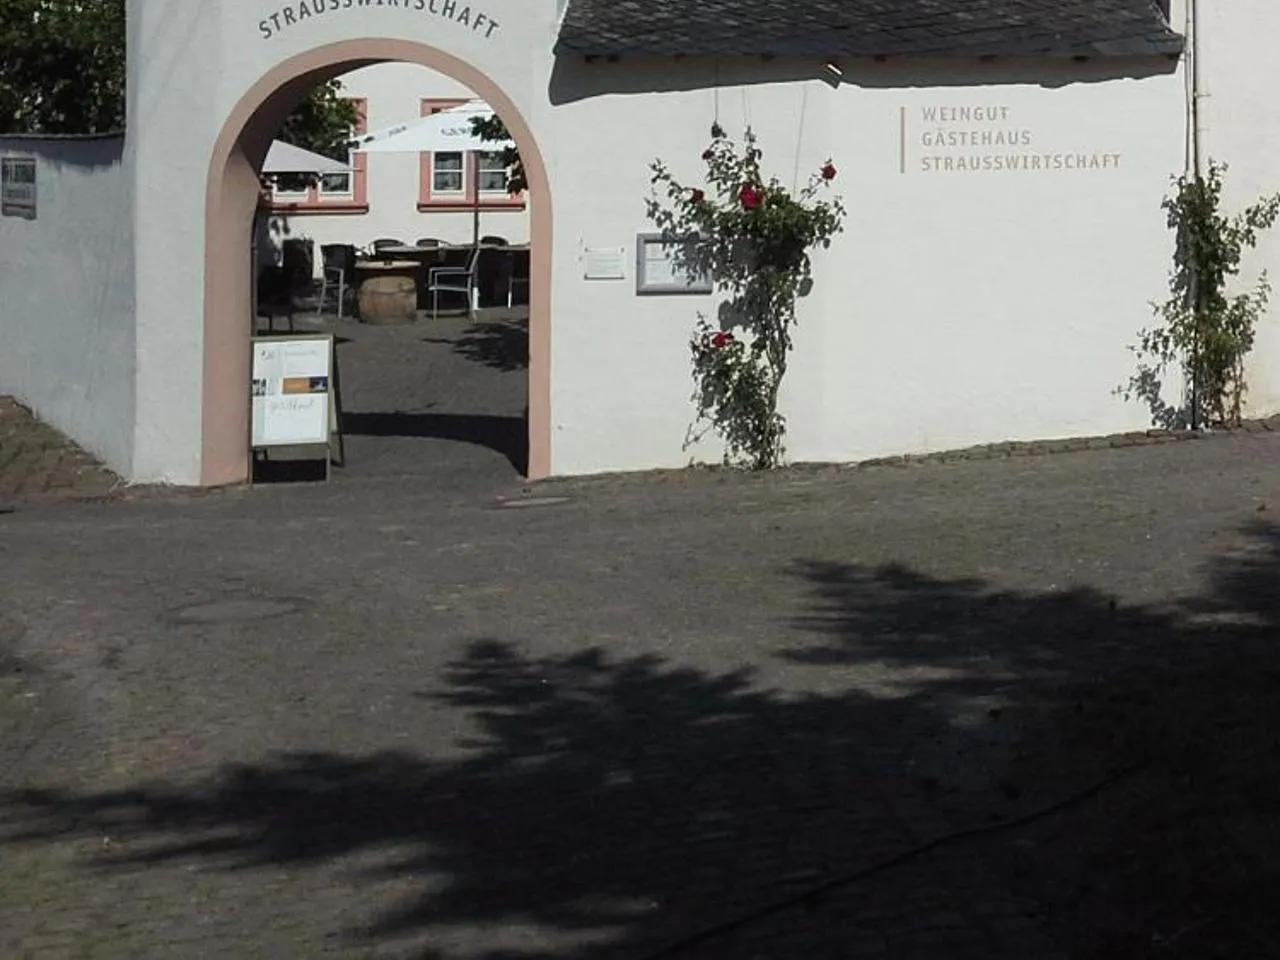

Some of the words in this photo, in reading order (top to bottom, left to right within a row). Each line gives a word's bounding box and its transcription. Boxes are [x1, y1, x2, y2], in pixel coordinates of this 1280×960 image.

[921, 105, 1010, 122] WEINGUT
[921, 127, 1031, 146] GÄSTEHAUS
[921, 153, 1122, 171] STRAUSSWIRTSCHAFT
